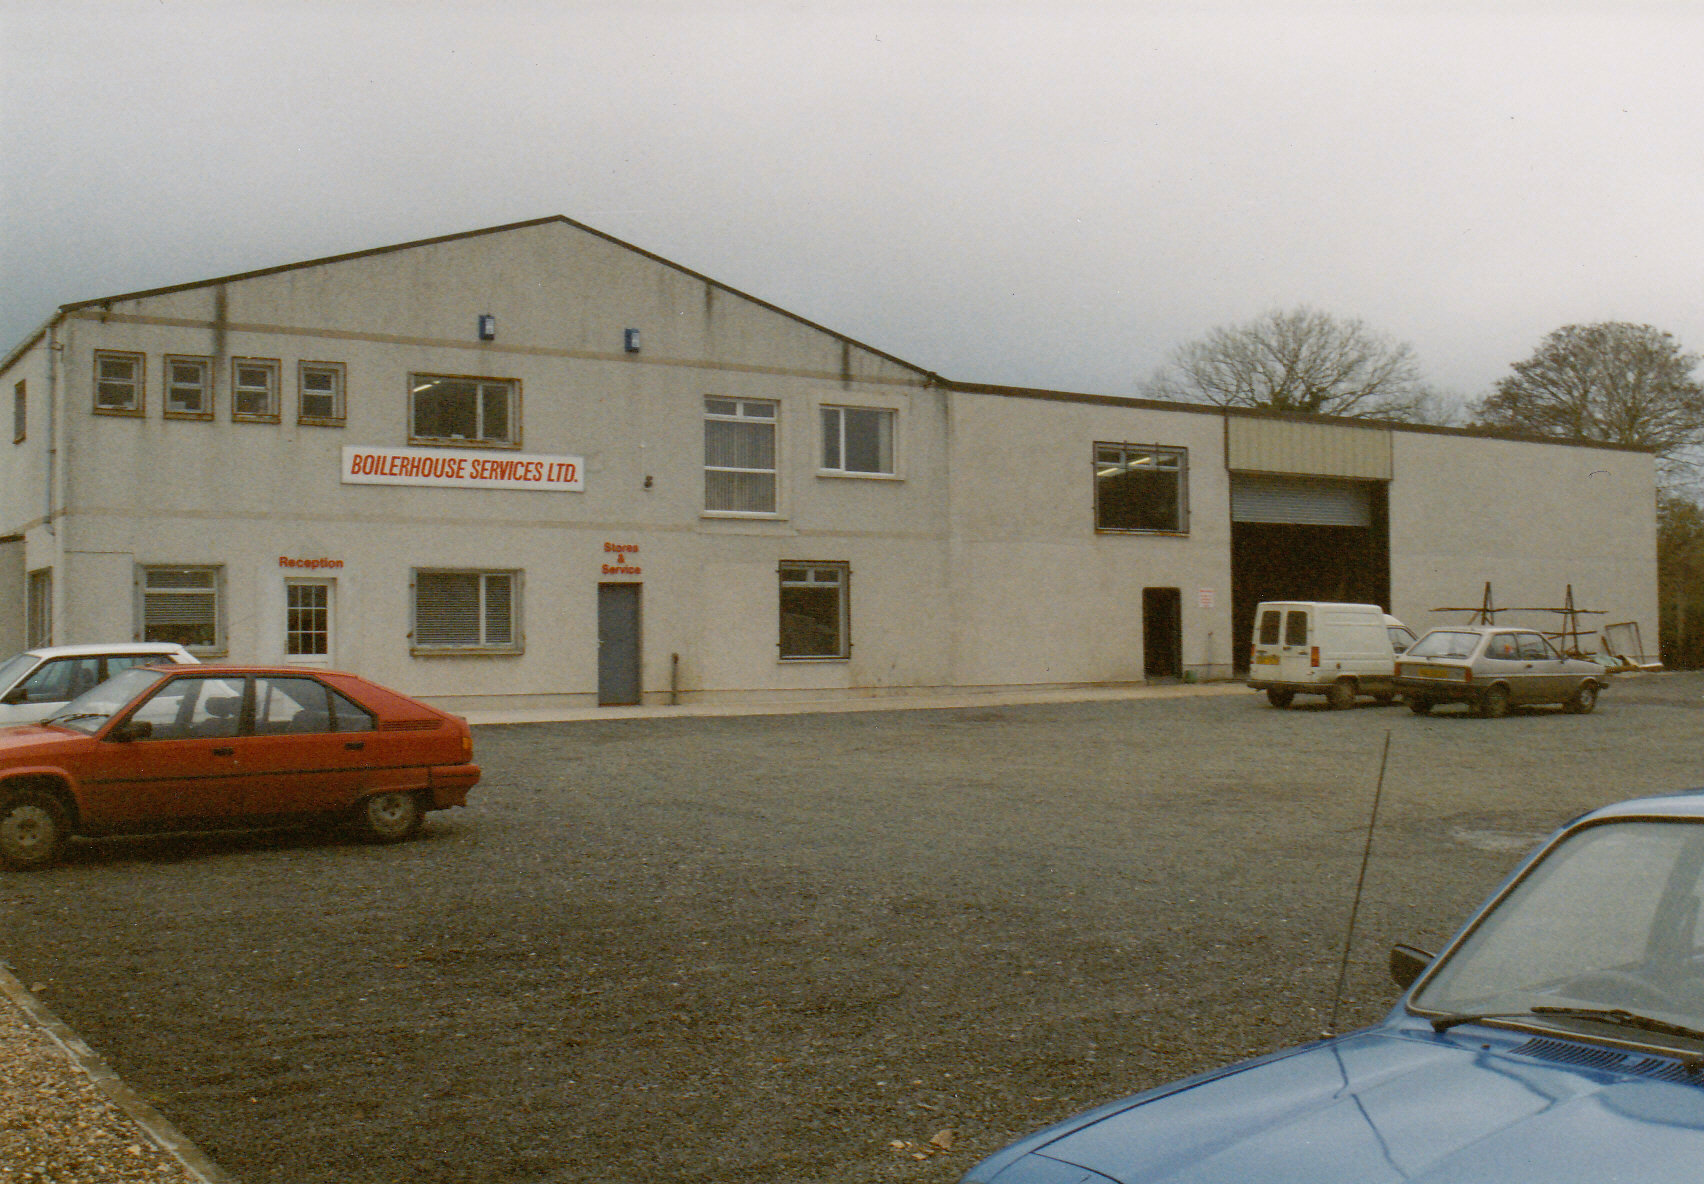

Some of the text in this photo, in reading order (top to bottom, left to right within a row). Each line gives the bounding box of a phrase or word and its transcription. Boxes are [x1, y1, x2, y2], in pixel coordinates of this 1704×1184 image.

[351, 454, 579, 483] BOILERHOUSE SERVICES LTD.
[603, 542, 639, 552] Stores
[279, 556, 344, 570] Reception
[617, 553, 625, 563] &
[602, 564, 641, 574] Service
